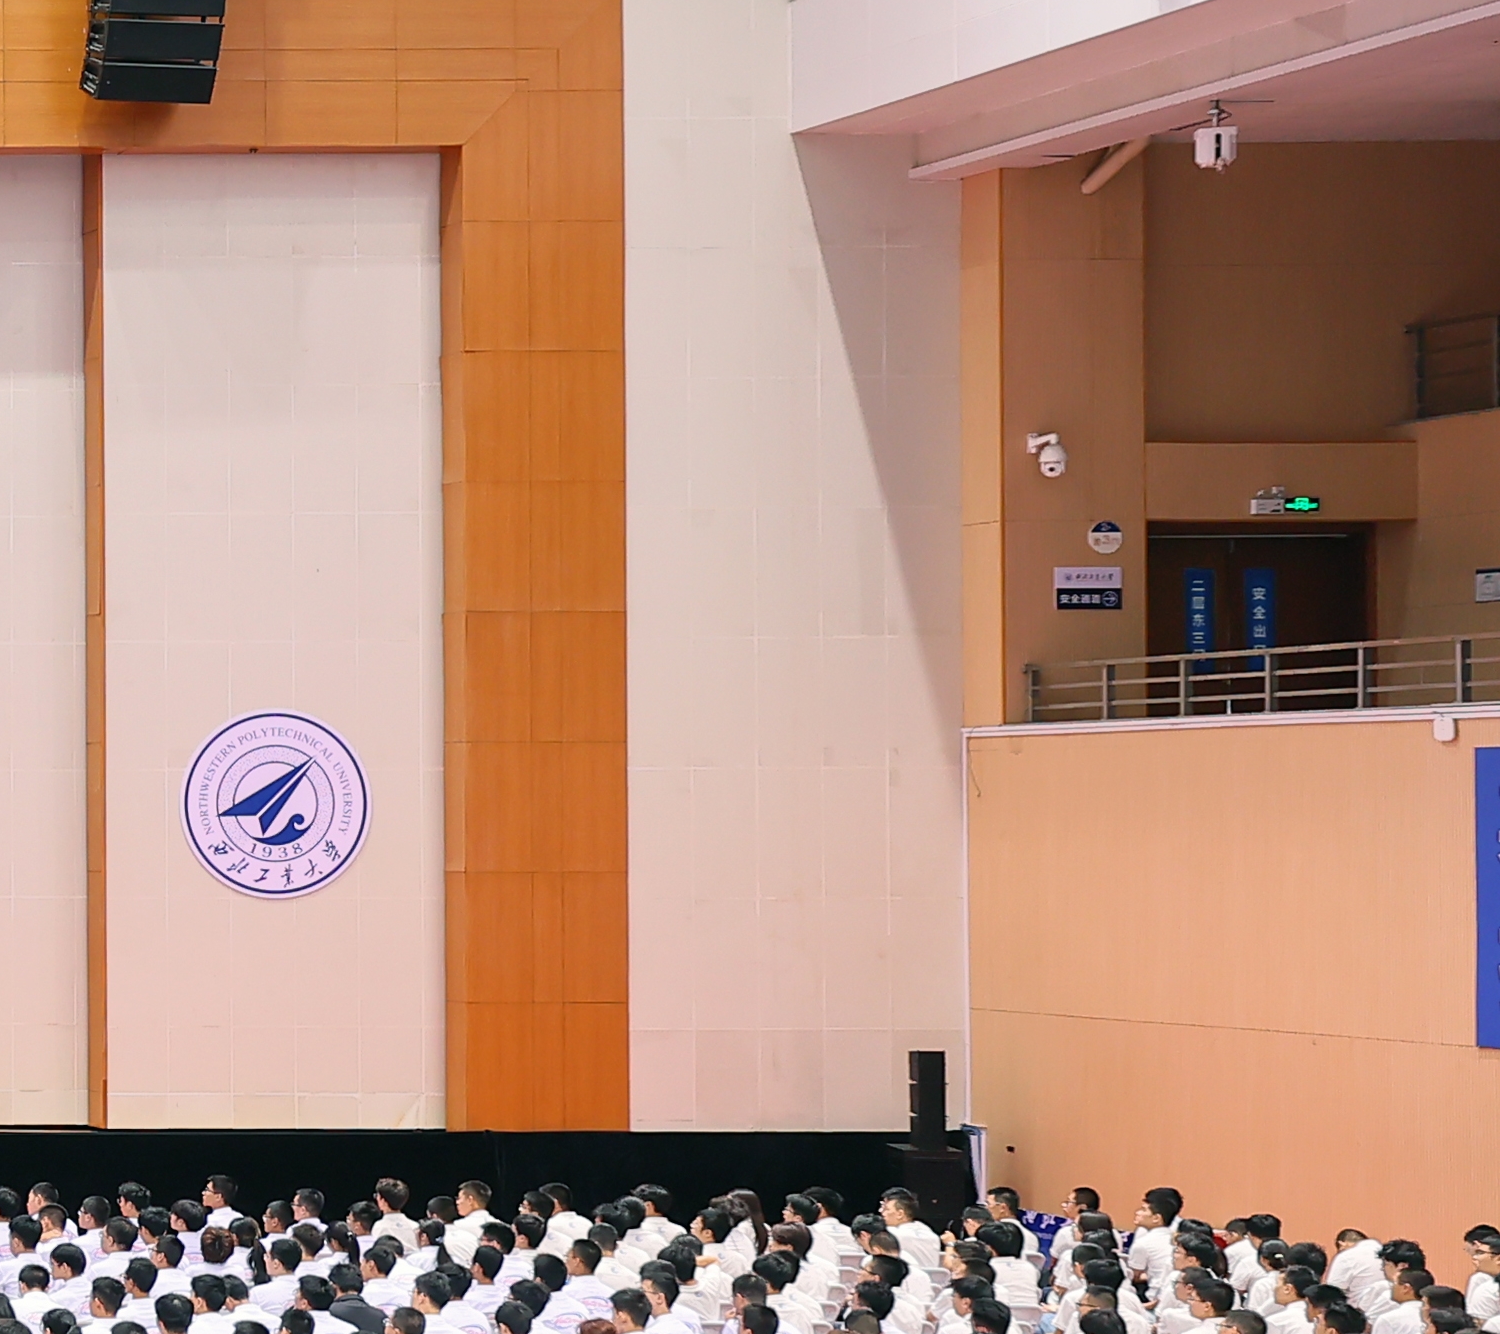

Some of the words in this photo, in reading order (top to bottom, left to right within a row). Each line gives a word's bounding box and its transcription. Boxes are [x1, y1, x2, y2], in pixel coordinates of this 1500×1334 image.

[1059, 593, 1100, 604] 安全通道
[1252, 587, 1266, 650] 安全出
[199, 741, 237, 836] NORTHWESTERN
[237, 727, 334, 763] POLYTECHNICAL
[332, 762, 353, 836] UNIVERSITY
[249, 842, 304, 858] 1938
